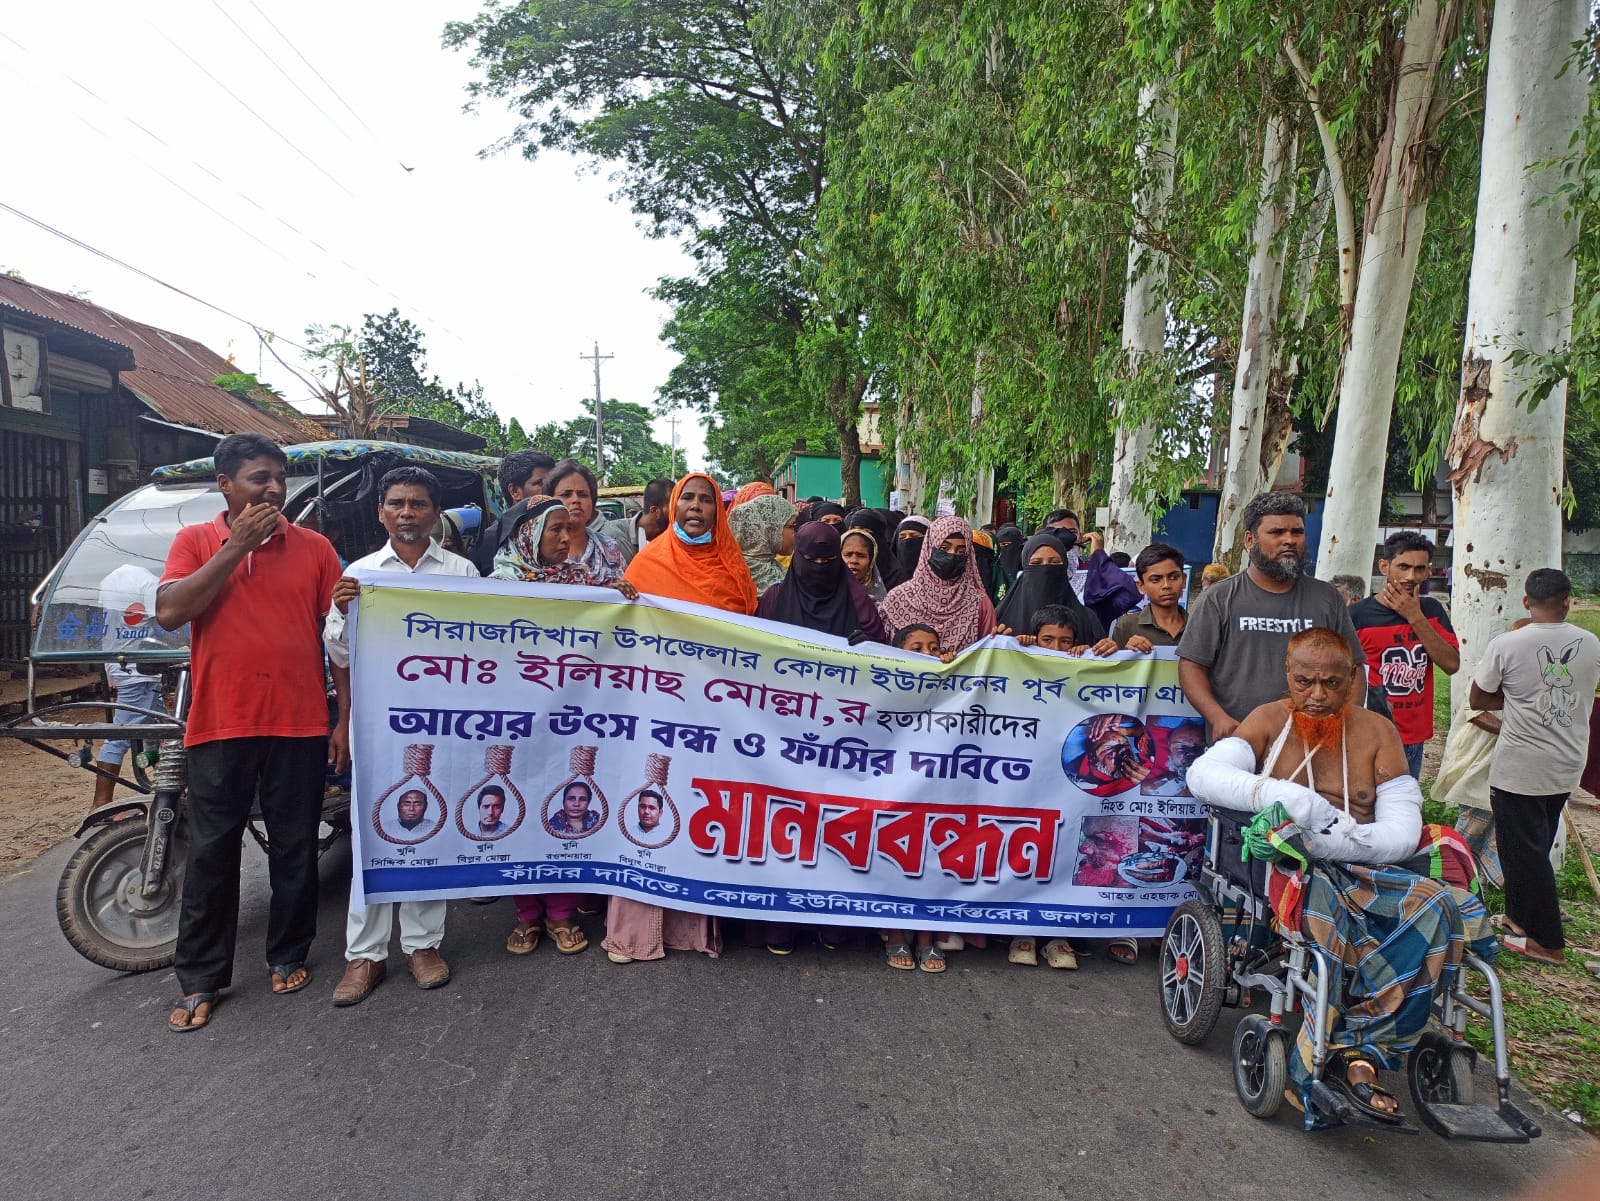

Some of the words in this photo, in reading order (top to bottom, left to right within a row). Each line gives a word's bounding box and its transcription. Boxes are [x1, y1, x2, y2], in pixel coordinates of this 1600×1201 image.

[402, 611, 602, 650] সিরাজদিখান
[611, 625, 762, 671] উপজেলার
[774, 656, 860, 686] কোলা
[870, 663, 1010, 696] ইউনিয়নের
[1022, 676, 1072, 704] পূর্ব
[1078, 683, 1150, 704] কোলা
[1239, 616, 1313, 633] FREESTYLE
[396, 652, 499, 685] মোঃ
[516, 651, 686, 702] ইলিয়াছ
[876, 704, 1040, 740] হত্যাকারীদের
[388, 707, 536, 741] আয়ের
[549, 705, 639, 741] উৎস
[650, 719, 721, 754] বন্ধ
[732, 733, 766, 758] ও
[780, 732, 896, 777] ফাঁসির
[910, 744, 1033, 784] দাবিতে
[687, 776, 1063, 884] মানববন্ধন
[1101, 799, 1126, 814] নিহত
[1129, 801, 1153, 814] মোঃ
[1157, 799, 1197, 816] ইলিয়াছ
[498, 862, 583, 882] ফাঁসির
[703, 888, 777, 908] কোলা
[786, 891, 915, 917] ইউনিয়নের
[1039, 907, 1117, 925] জনগণ
[1098, 891, 1135, 902] আহত
